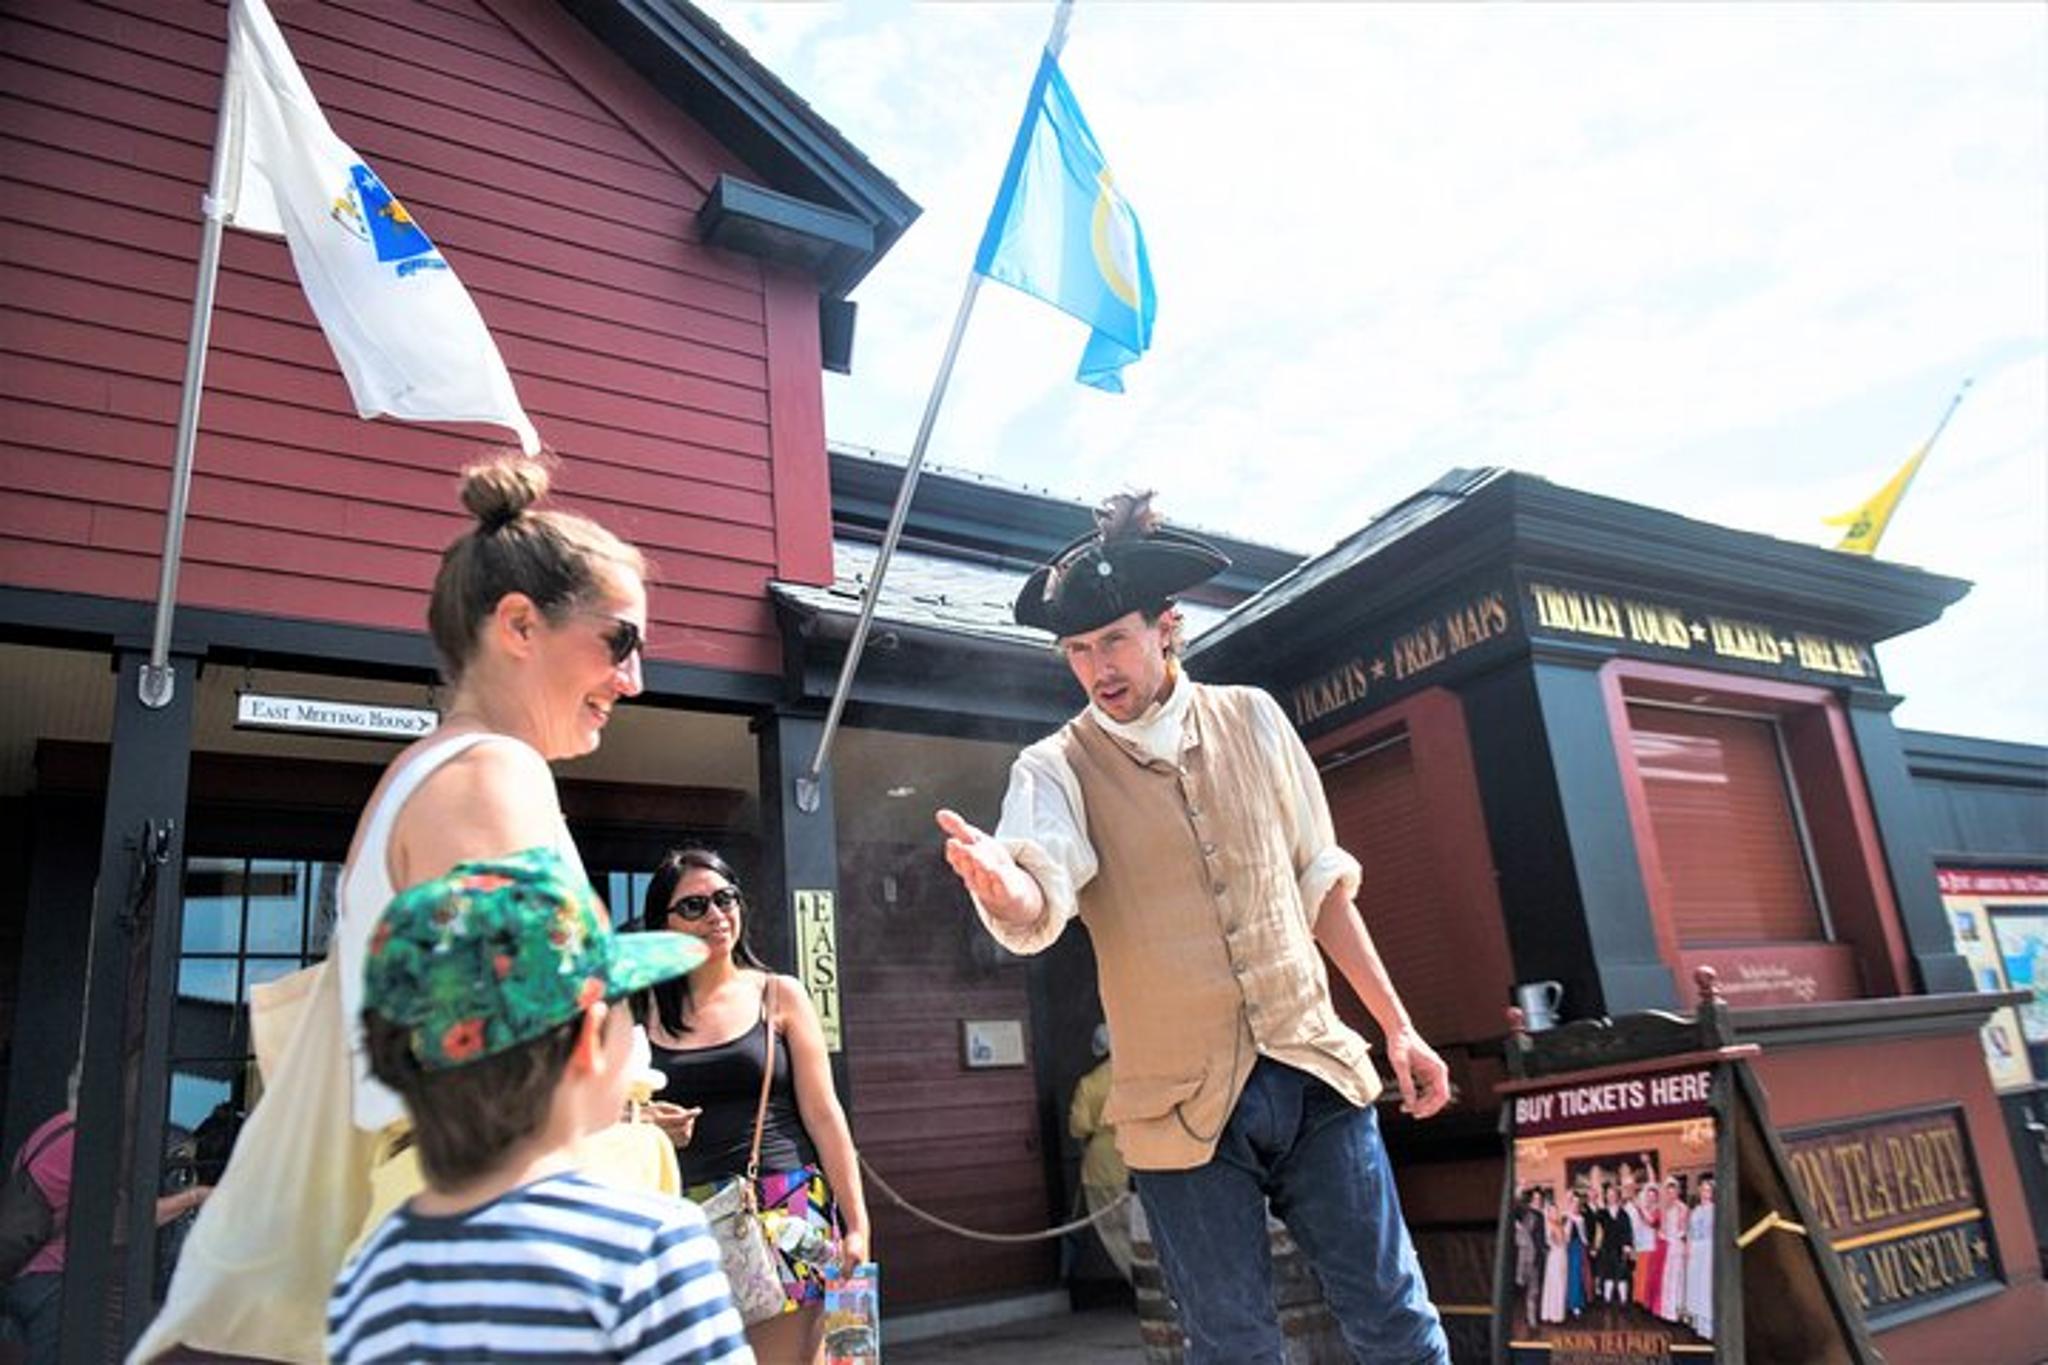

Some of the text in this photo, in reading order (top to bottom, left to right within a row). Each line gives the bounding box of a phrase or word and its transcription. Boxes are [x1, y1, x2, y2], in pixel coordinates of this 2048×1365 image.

[1392, 616, 1446, 680] FREE
[1446, 594, 1508, 655] MAPS
[1530, 584, 1625, 638] TROLLEY
[1623, 601, 1691, 650] TOURS
[251, 700, 414, 729] EAST MEETING HOUSE
[811, 893, 836, 1018] EAST
[1515, 1071, 1712, 1124] BUY TICKETS HERE
[1834, 1134, 1898, 1223] TEA
[1886, 1126, 1970, 1211] PARTY
[1868, 1229, 1977, 1303] MUSEUM
